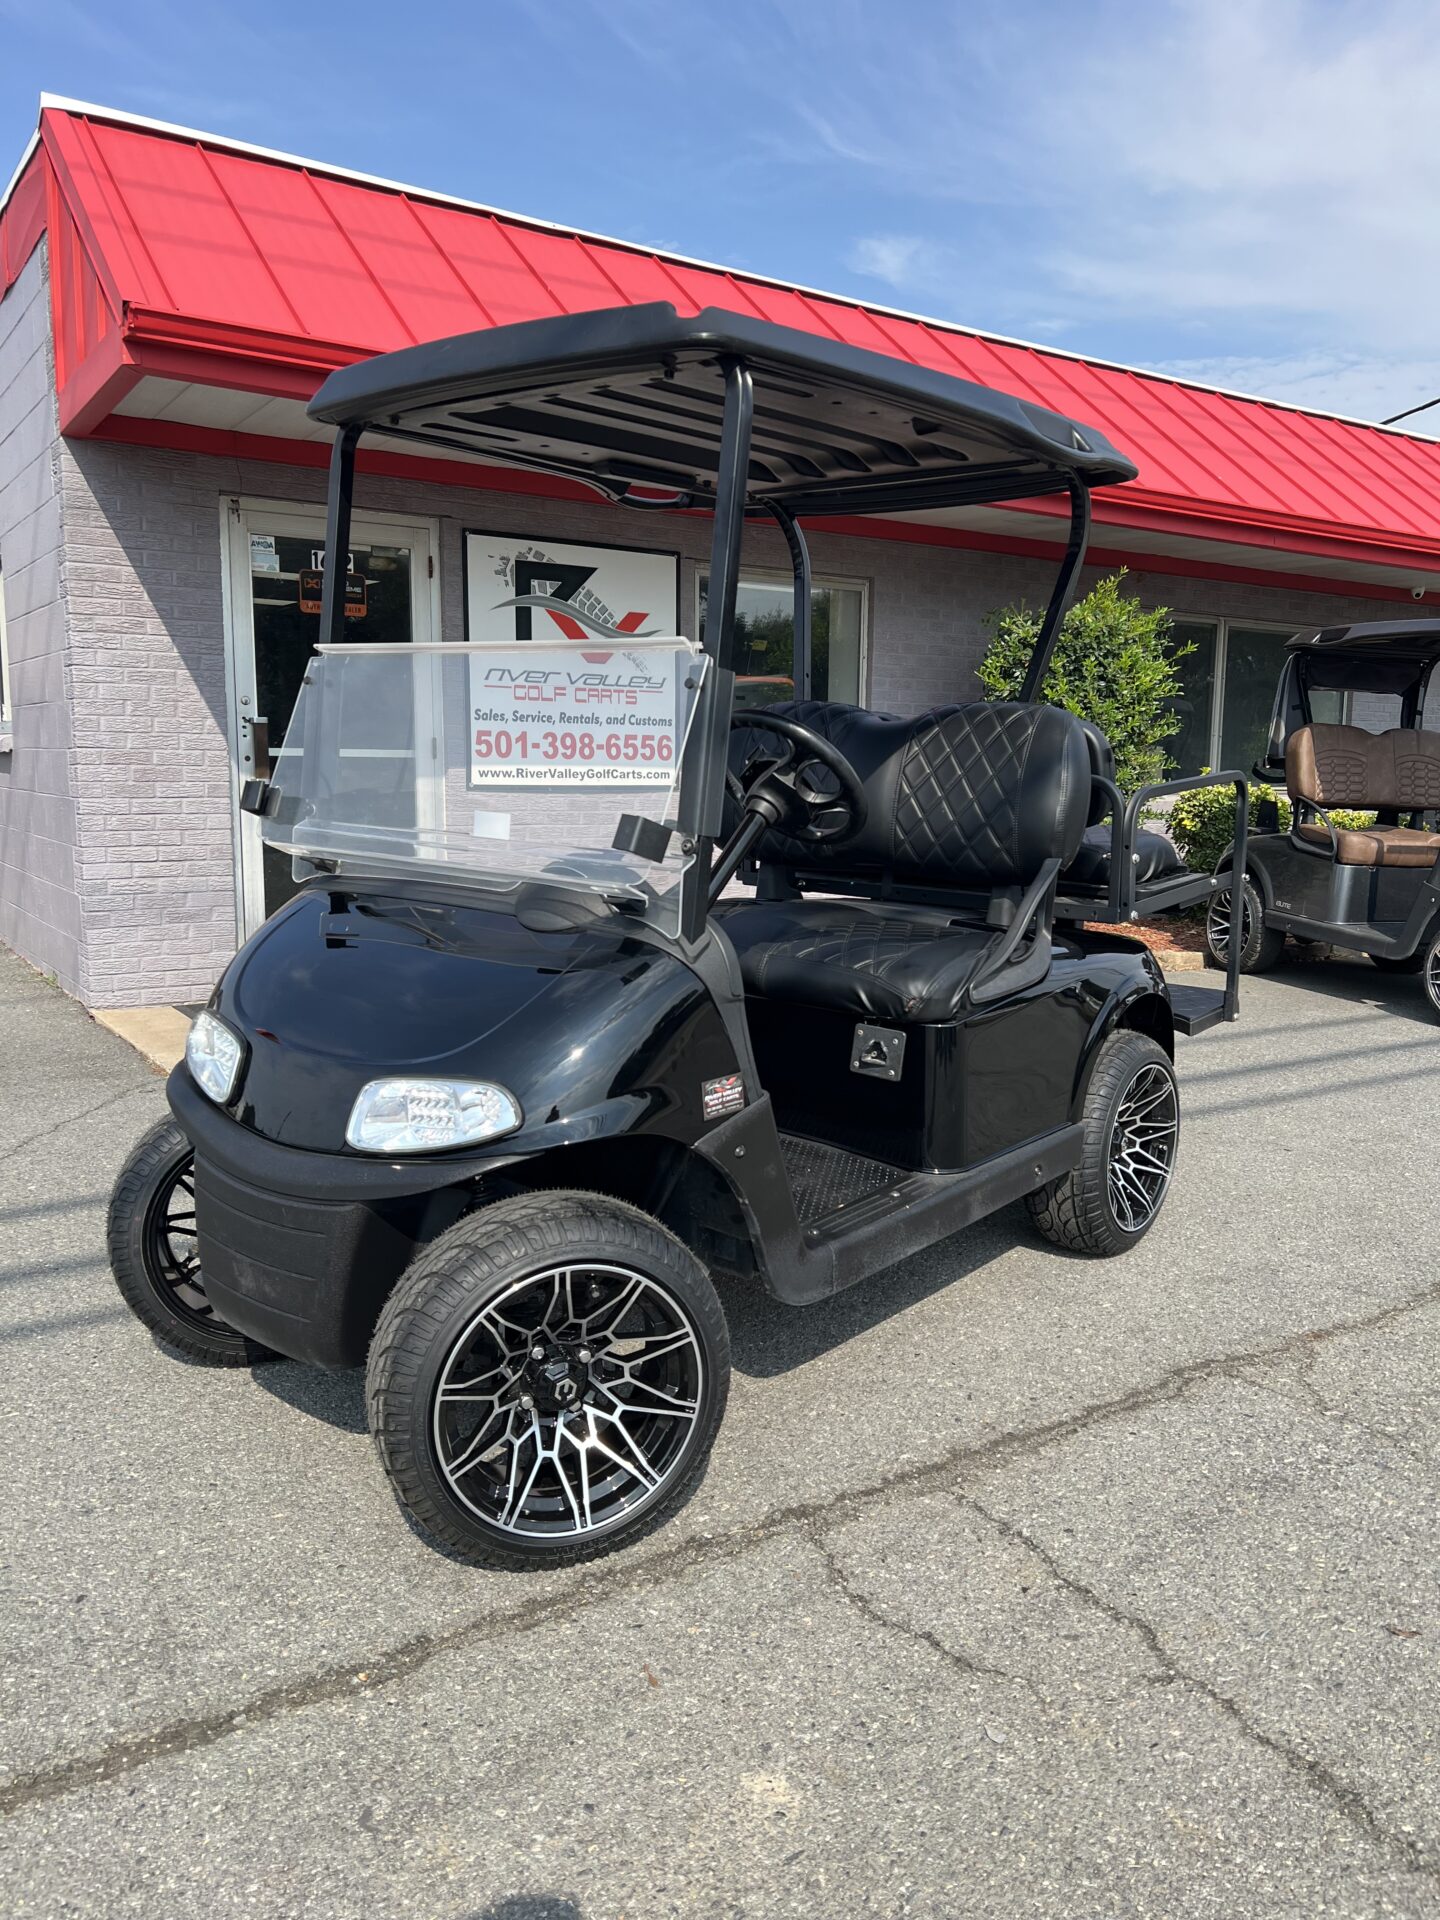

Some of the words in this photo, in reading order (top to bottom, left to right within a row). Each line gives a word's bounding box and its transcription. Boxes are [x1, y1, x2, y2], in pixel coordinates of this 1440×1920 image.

[513, 684, 567, 703] GOLF
[574, 687, 638, 705] CARTS
[474, 708, 509, 724] Sales,
[512, 710, 556, 726] Service,
[558, 712, 602, 727] Rentals,
[605, 713, 626, 726] and
[628, 714, 673, 727] Customs
[474, 729, 673, 761] 501-398-6556
[478, 768, 671, 781] www.RiverValleyGolfCarts.com
